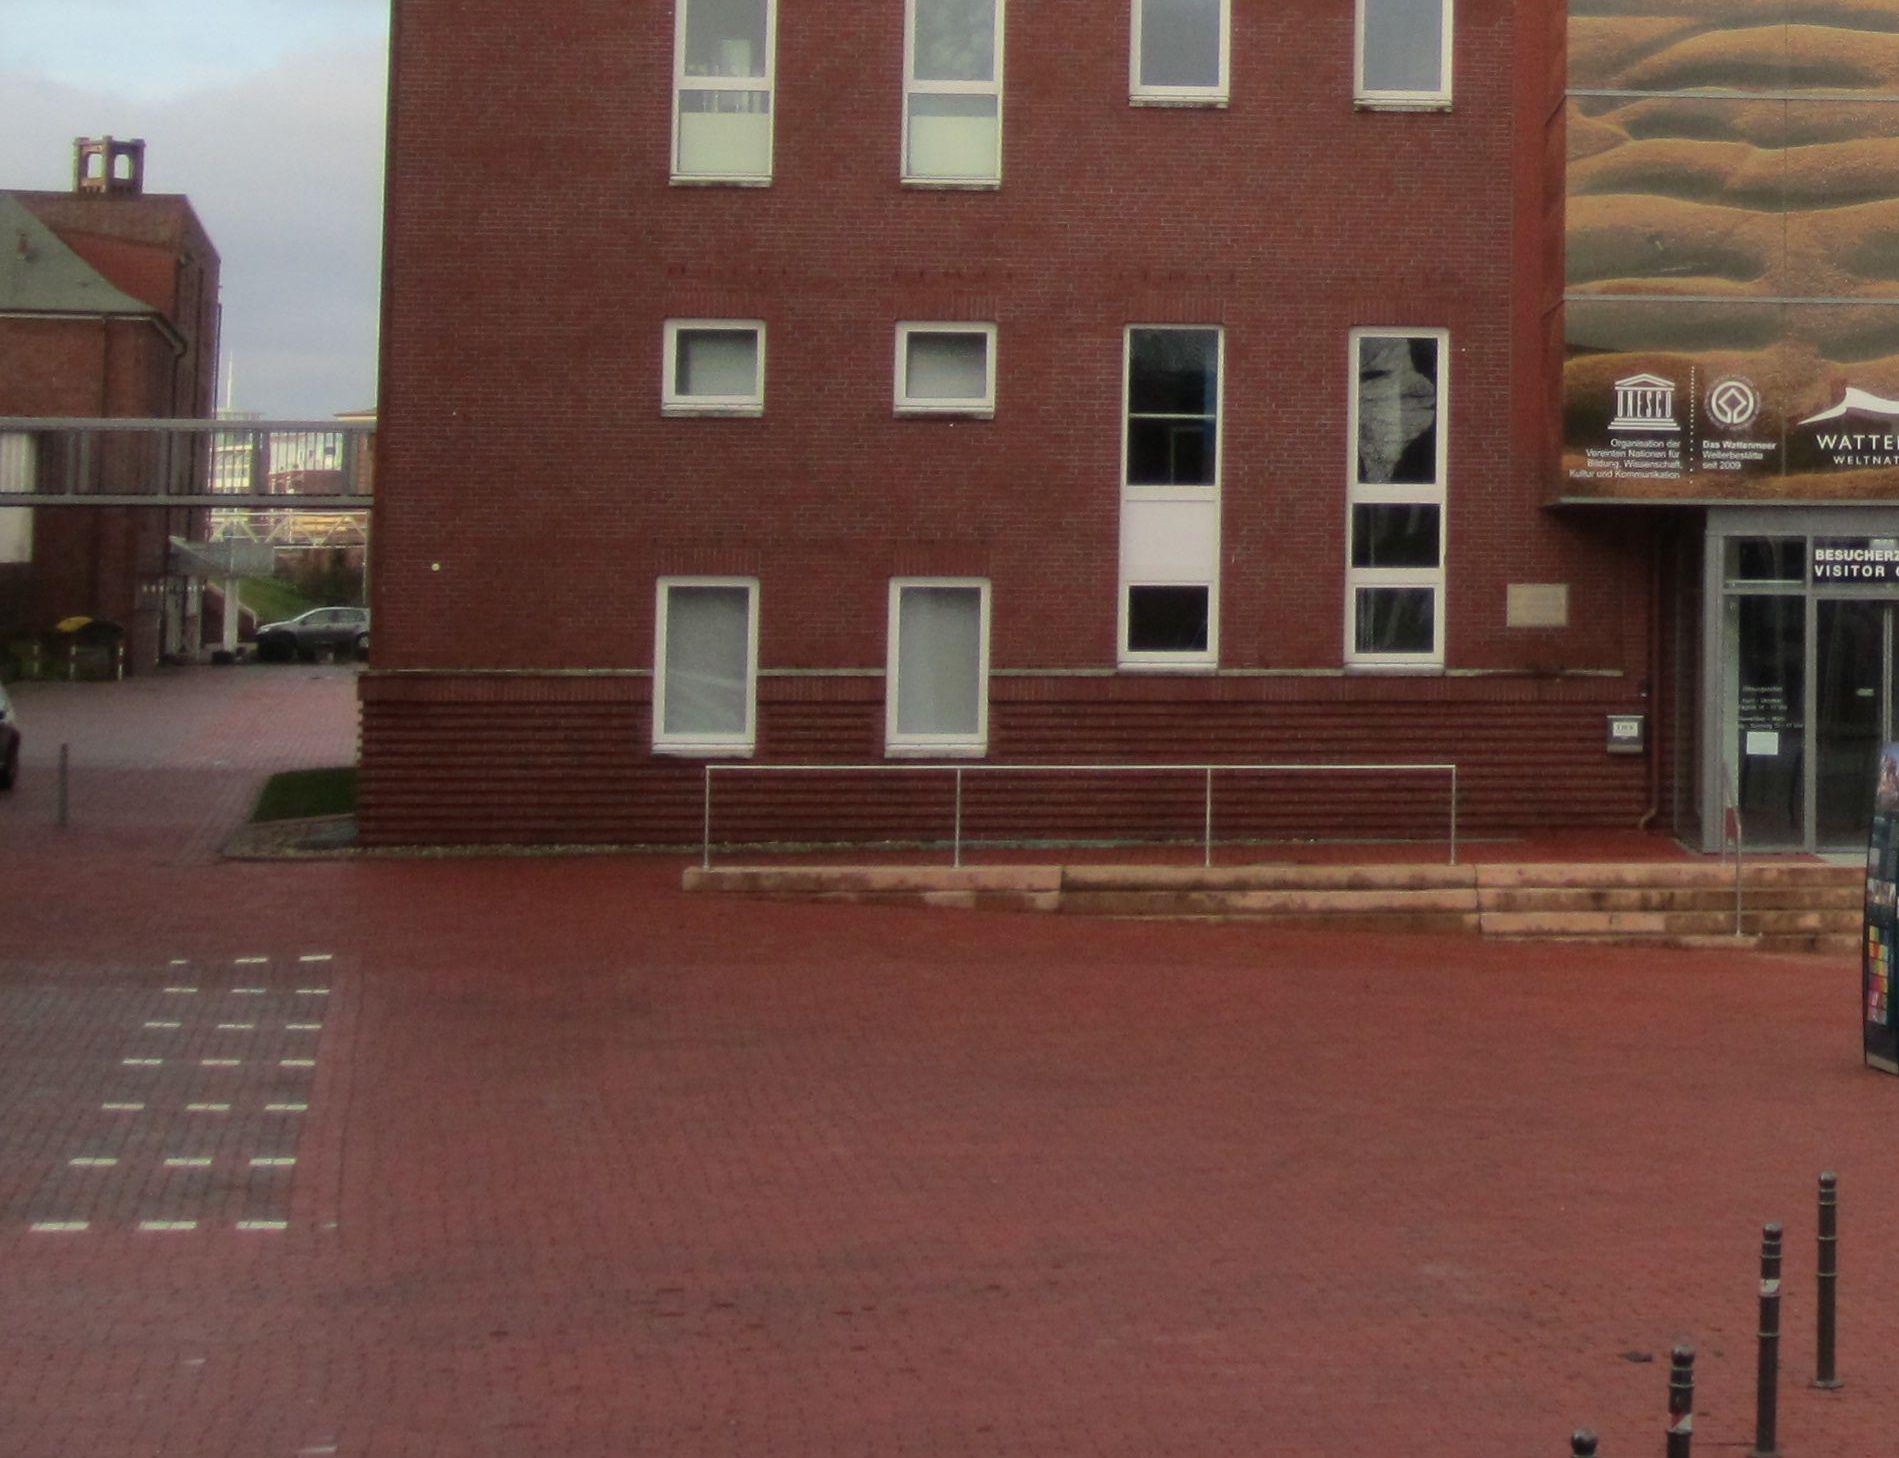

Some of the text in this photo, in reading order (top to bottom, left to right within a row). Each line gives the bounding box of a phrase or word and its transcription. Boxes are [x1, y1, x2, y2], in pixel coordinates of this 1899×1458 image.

[1616, 390, 1673, 419] UNESCO
[1702, 440, 1777, 451] Das Wattenmeer
[1628, 449, 1667, 459] Nationen
[1719, 461, 1742, 471] 2009
[1596, 470, 1613, 479] und
[1814, 564, 1886, 578] VISITOR
